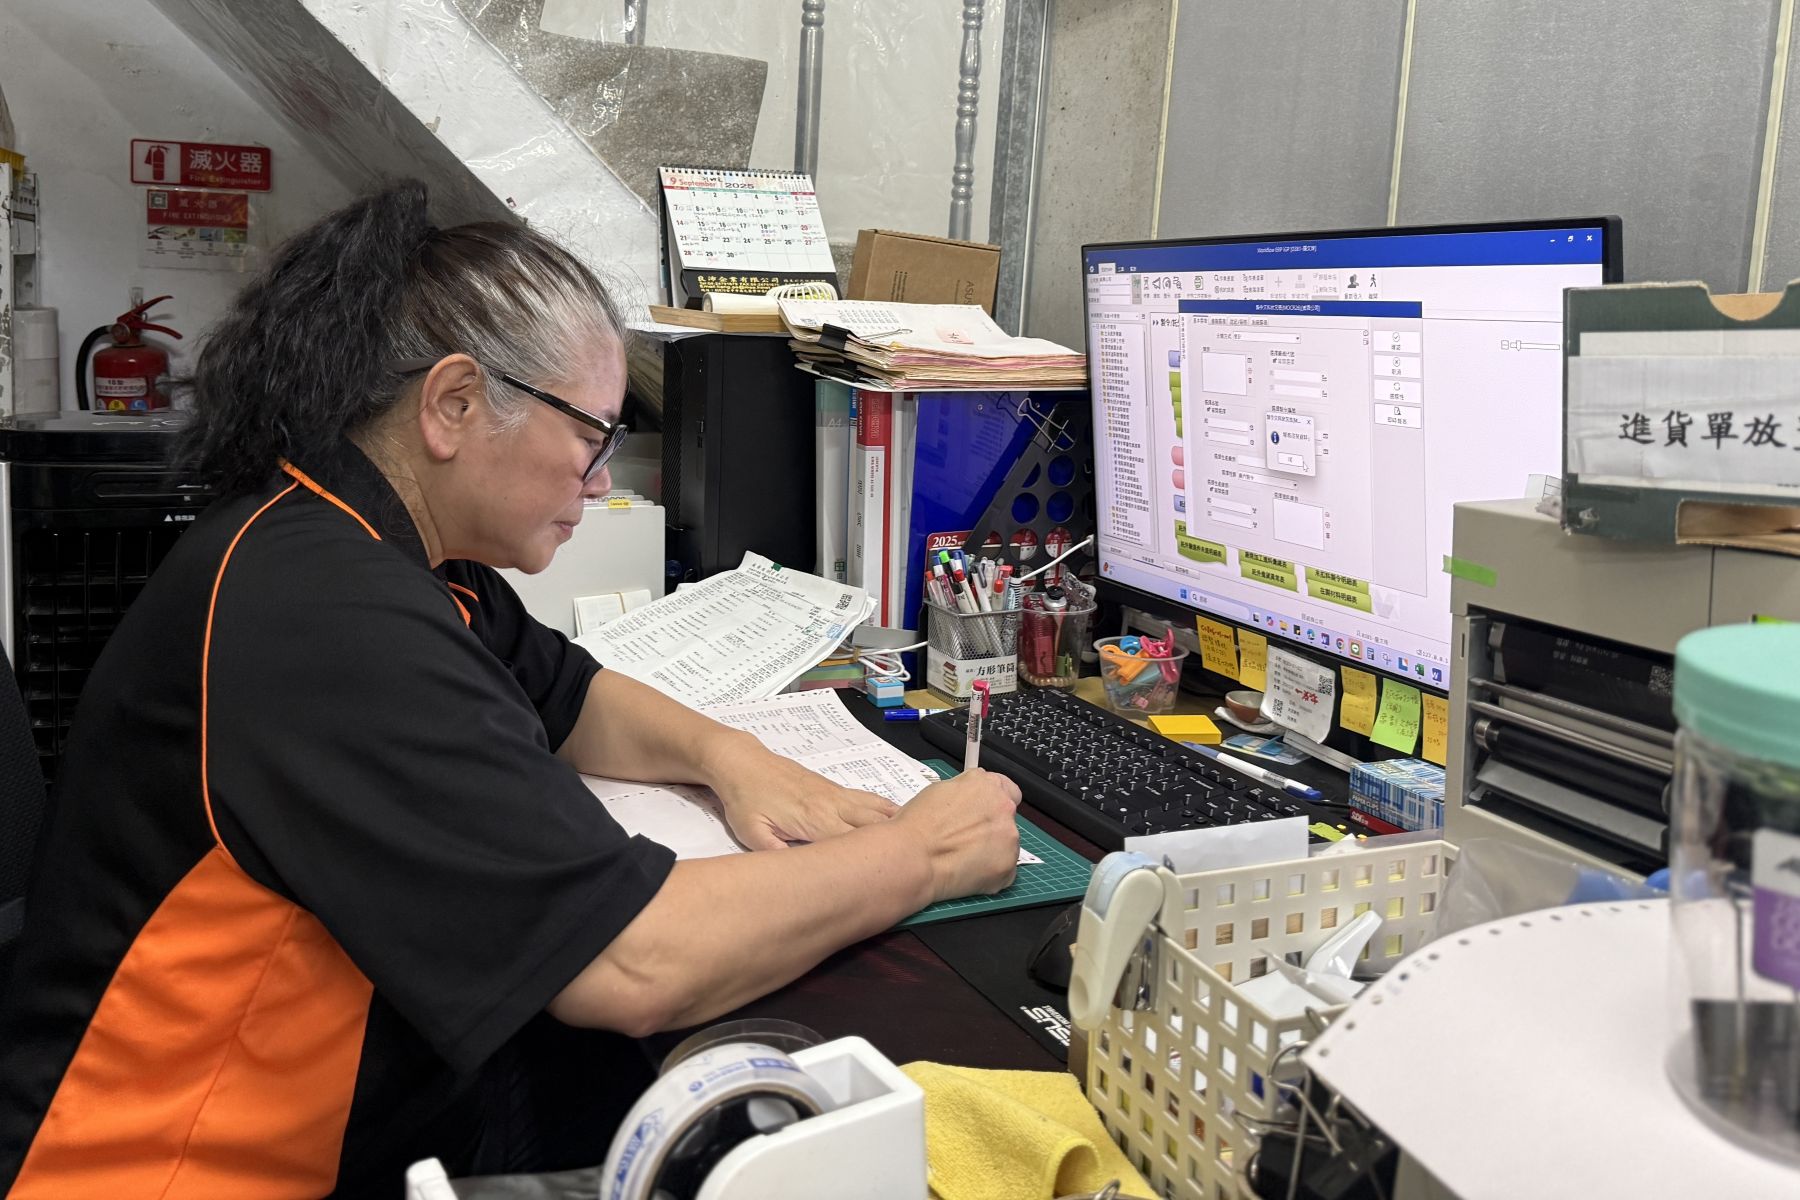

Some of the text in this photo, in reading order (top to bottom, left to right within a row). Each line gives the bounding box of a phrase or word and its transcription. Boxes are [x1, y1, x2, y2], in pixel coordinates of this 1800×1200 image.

[189, 149, 263, 174] 滅火器
[670, 176, 676, 185] 9
[679, 179, 716, 188] September
[828, 418, 842, 428] A4
[932, 536, 958, 548] 2025
[976, 662, 1016, 676] 方形筆筒
[1352, 795, 1366, 806] PAPER
[1020, 1006, 1070, 1047] SUS
